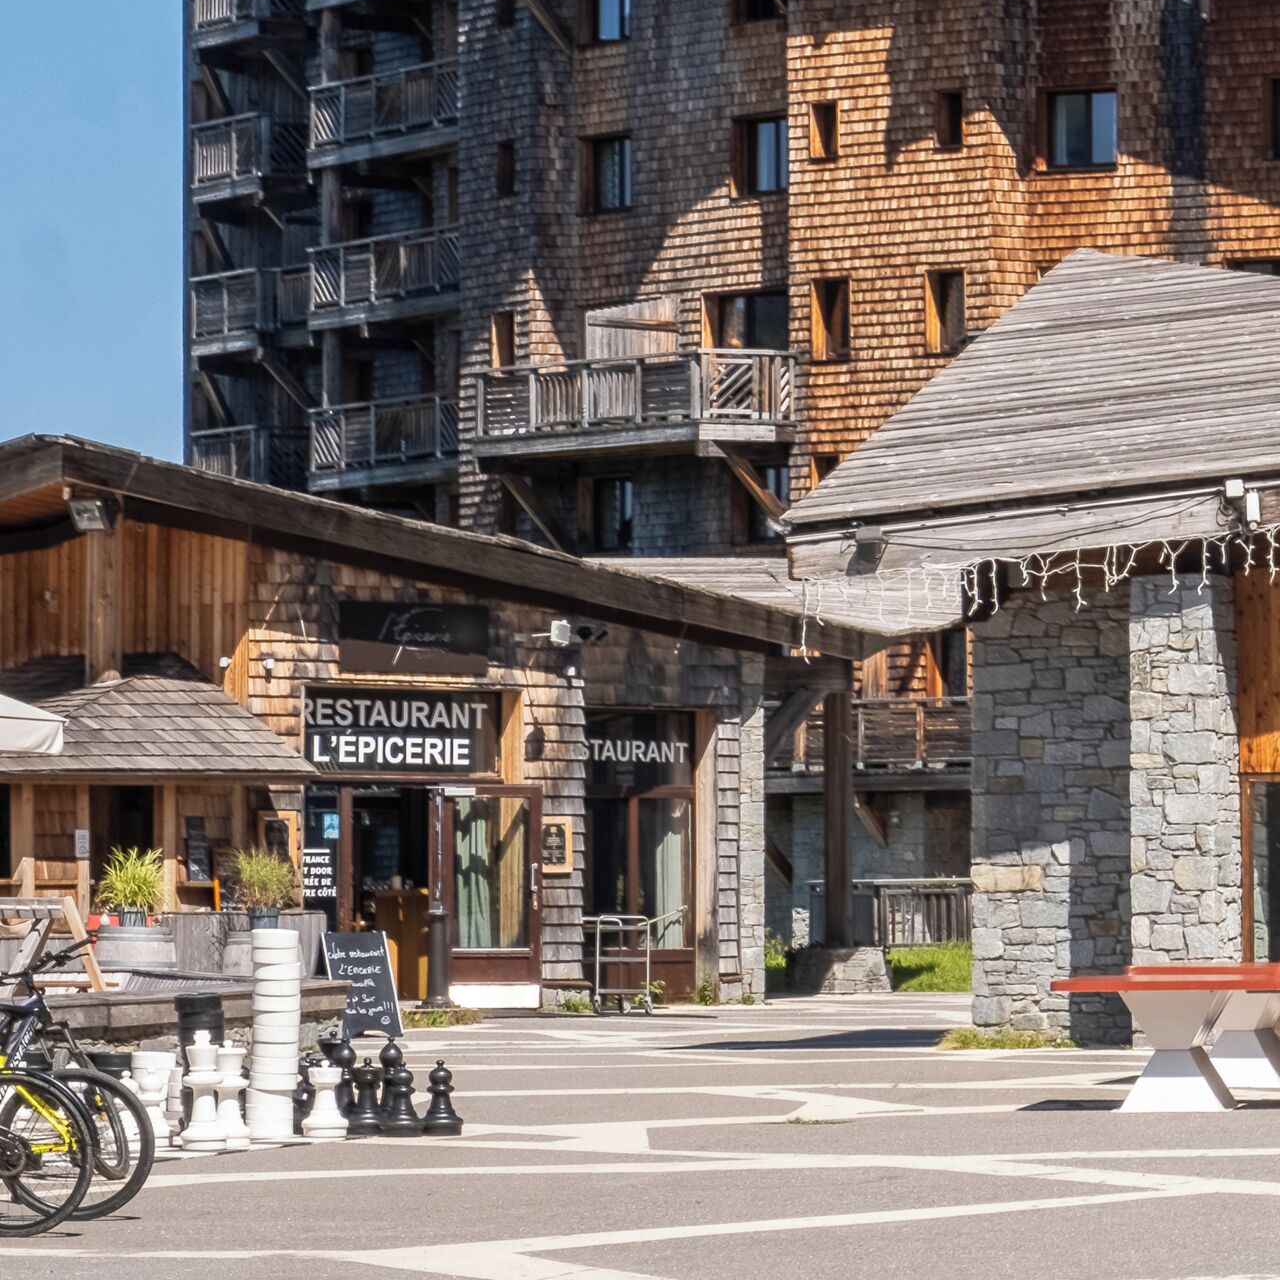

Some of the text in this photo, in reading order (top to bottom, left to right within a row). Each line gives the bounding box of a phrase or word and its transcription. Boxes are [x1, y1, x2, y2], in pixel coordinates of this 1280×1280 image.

[304, 698, 488, 730] RESTAURANT
[313, 729, 470, 766] L'ÉPICERIE
[310, 867, 333, 875] DOOR
[321, 878, 332, 886] DE
[317, 886, 337, 897] CÔTÉ
